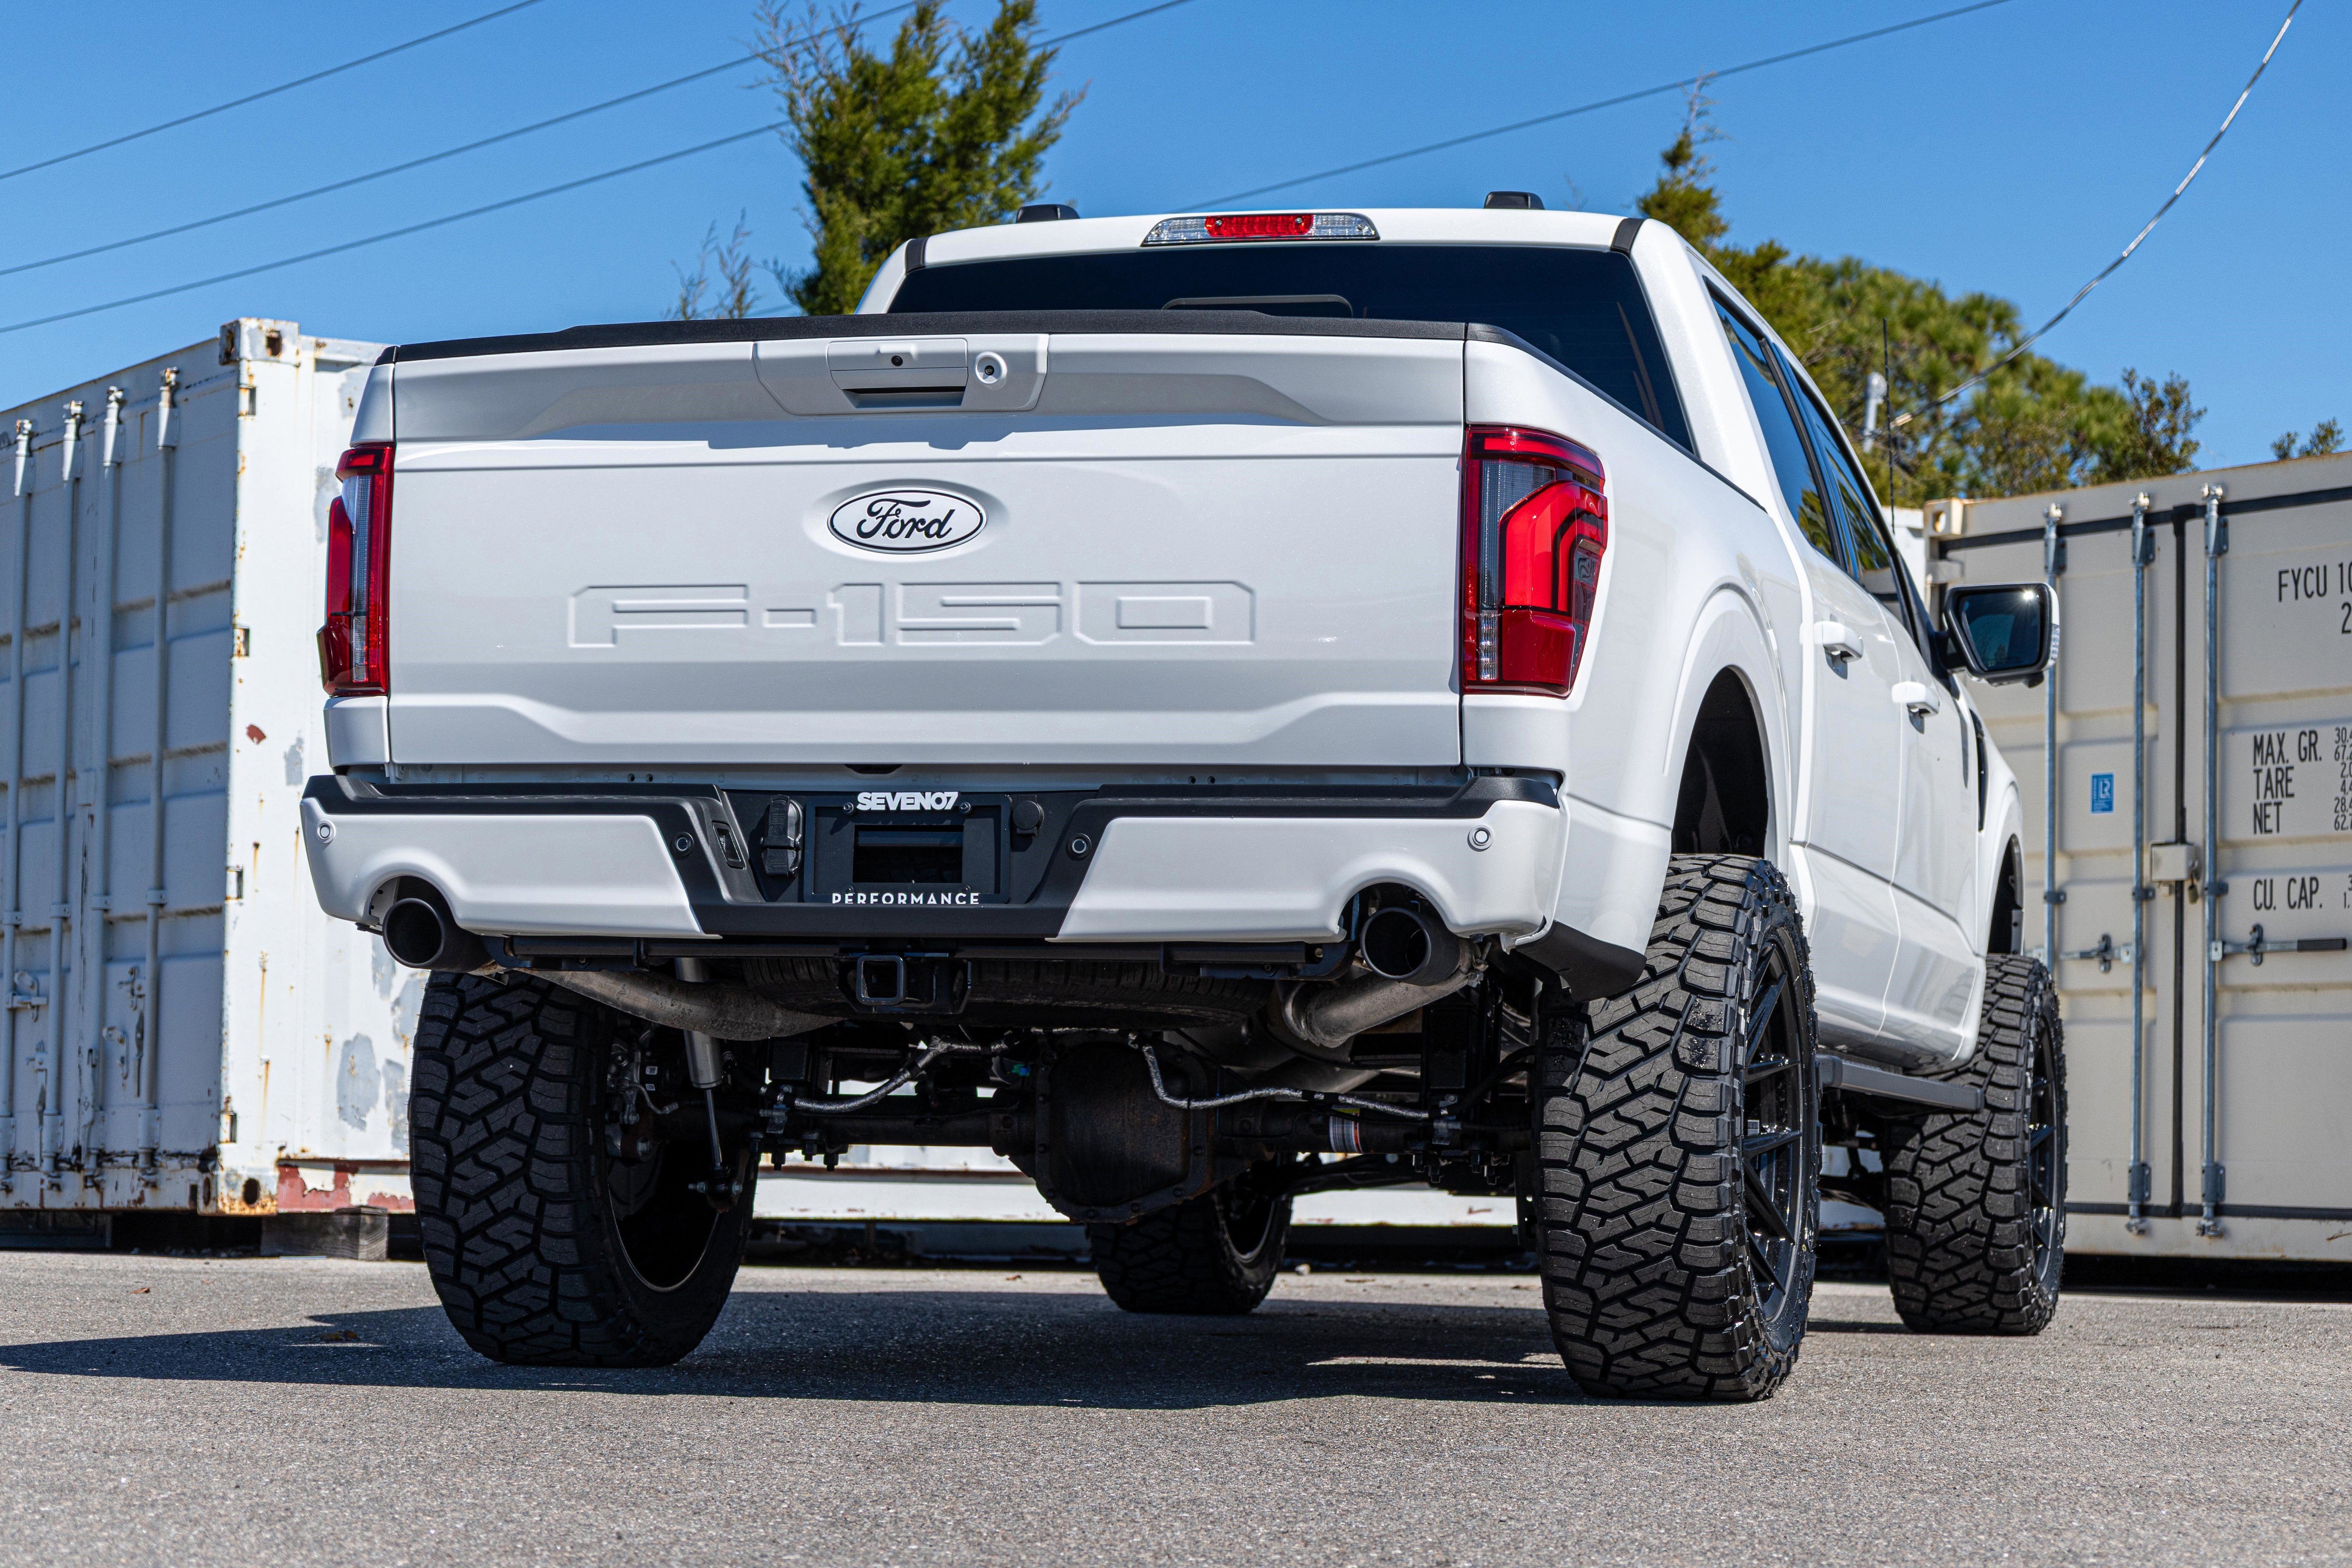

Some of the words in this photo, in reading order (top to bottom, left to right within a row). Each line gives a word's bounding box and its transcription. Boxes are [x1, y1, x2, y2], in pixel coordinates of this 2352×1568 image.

[857, 498, 956, 539] Ford
[2278, 564, 2327, 602] FYCU
[568, 581, 1257, 648] F-150
[2253, 733, 2290, 766] MAX.
[2298, 729, 2323, 762] GR.
[2253, 765, 2295, 800] TARE
[2253, 801, 2283, 835] NET
[832, 893, 980, 904] PERFORMANCE
[2254, 879, 2276, 911] CU.
[2287, 877, 2323, 910] CAP.
